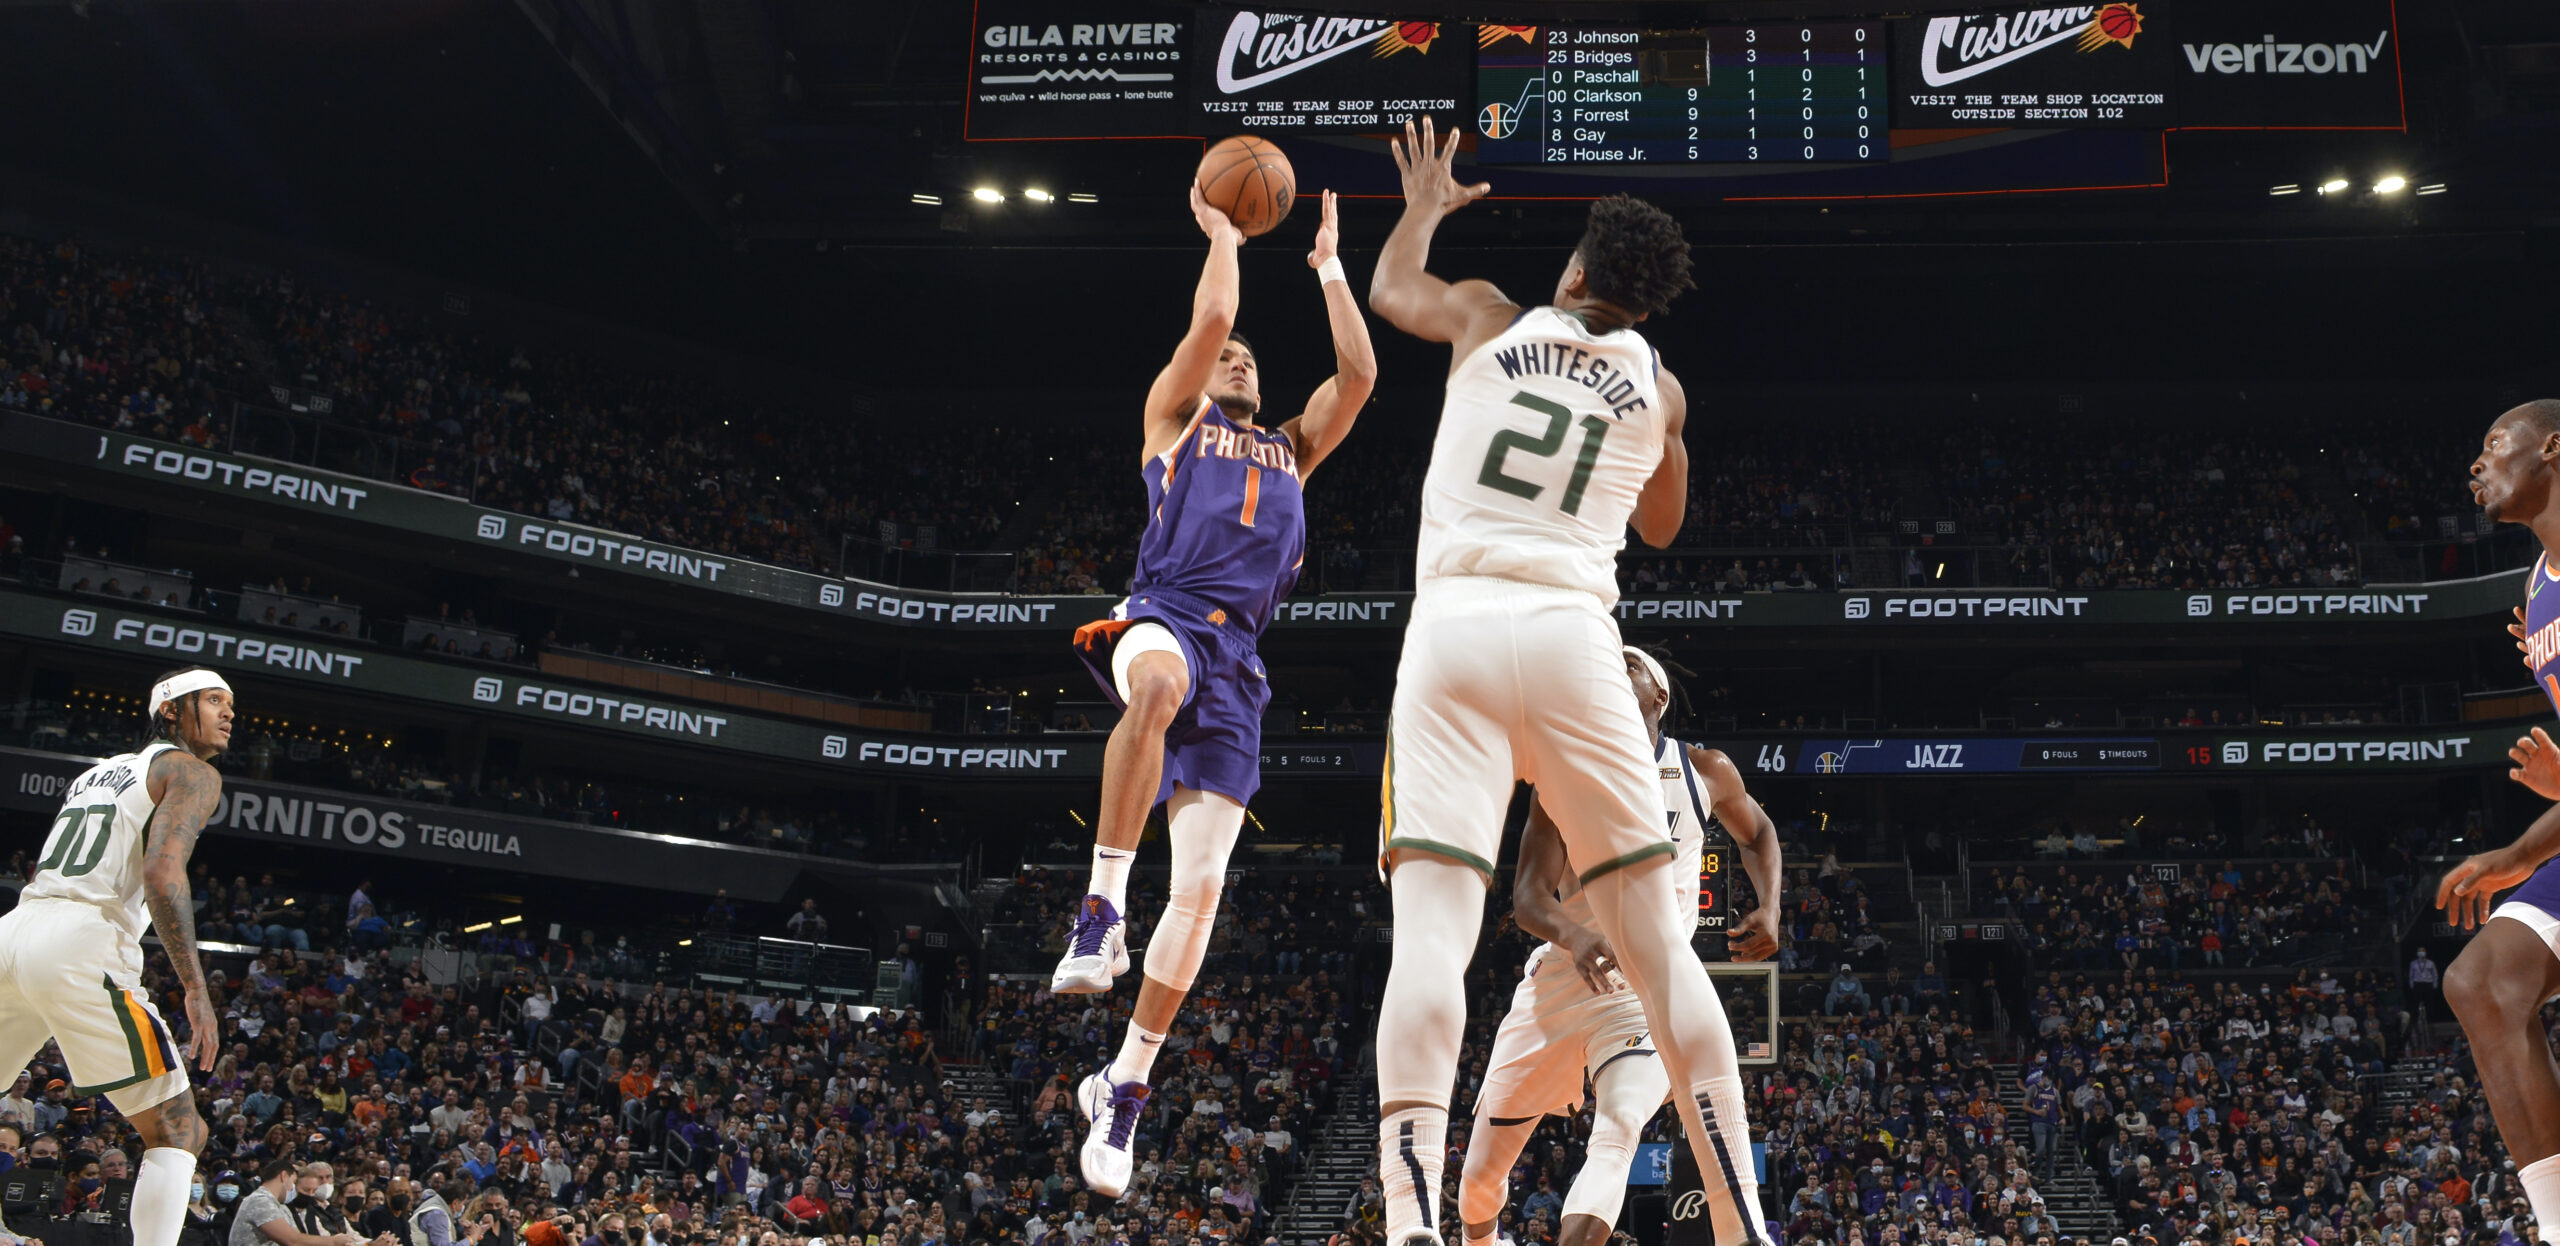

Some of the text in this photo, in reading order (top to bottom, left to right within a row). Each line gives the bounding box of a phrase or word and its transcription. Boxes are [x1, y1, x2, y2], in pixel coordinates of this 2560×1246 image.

[984, 22, 1176, 48] GILA RIVER
[1548, 28, 1866, 45] 23 Johnson 3 0 0
[980, 51, 1180, 63] RESORTS & CASINOS
[1547, 48, 1864, 67] 25 Bridges 3 1 1
[2182, 34, 2367, 74] verizon
[1552, 67, 1865, 84] 0 Paschall 1 0 1
[979, 90, 1174, 103] vee quiva wild horse pass lone butte
[1547, 86, 1865, 104] 00 Clarkson 9 1 2 1
[1910, 93, 2164, 106] VISIT THE TEAM SHOP LOCATION
[1202, 99, 1455, 113] VISIT THE TEAM SHOP LOCATION
[1552, 105, 1868, 123] 3 Forrest 9 1 0 0
[1951, 107, 2124, 120] OUTSIDE SECTION 102
[1242, 113, 1414, 126] OUTSIDE SECTION 102
[1551, 125, 1869, 145] 8 Gay 2 1 0 0
[1547, 144, 1869, 162] 25 House Jr. 5 3 0 0
[1494, 343, 1648, 421] WHITESIDE
[1196, 424, 1300, 482] PHOENIX
[1477, 391, 1610, 517] 21
[123, 444, 368, 510] FOOTPRINT
[1240, 464, 1261, 527] 1
[519, 524, 726, 582] FOOTPRINT
[856, 592, 1056, 624] FOOTPRINT
[1884, 597, 2089, 618] FOOTPRINT
[2226, 594, 2429, 615] FOOTPRINT
[113, 618, 363, 678] FOOTPRINT
[516, 684, 727, 738] FOOTPRINT
[859, 742, 1068, 769] FOOTPRINT
[1756, 744, 1964, 773] 46 JAZZ
[2042, 750, 2148, 760] 0 FOULS 5 TIMEOUTS
[2186, 747, 2211, 765] 15
[2263, 737, 2471, 762] FOOTPRINT
[1281, 755, 1288, 766] 5
[1300, 755, 1327, 764] FOULS
[1335, 755, 1342, 766] 2
[417, 823, 521, 857] TEQUILA
[2156, 867, 2175, 881] 121
